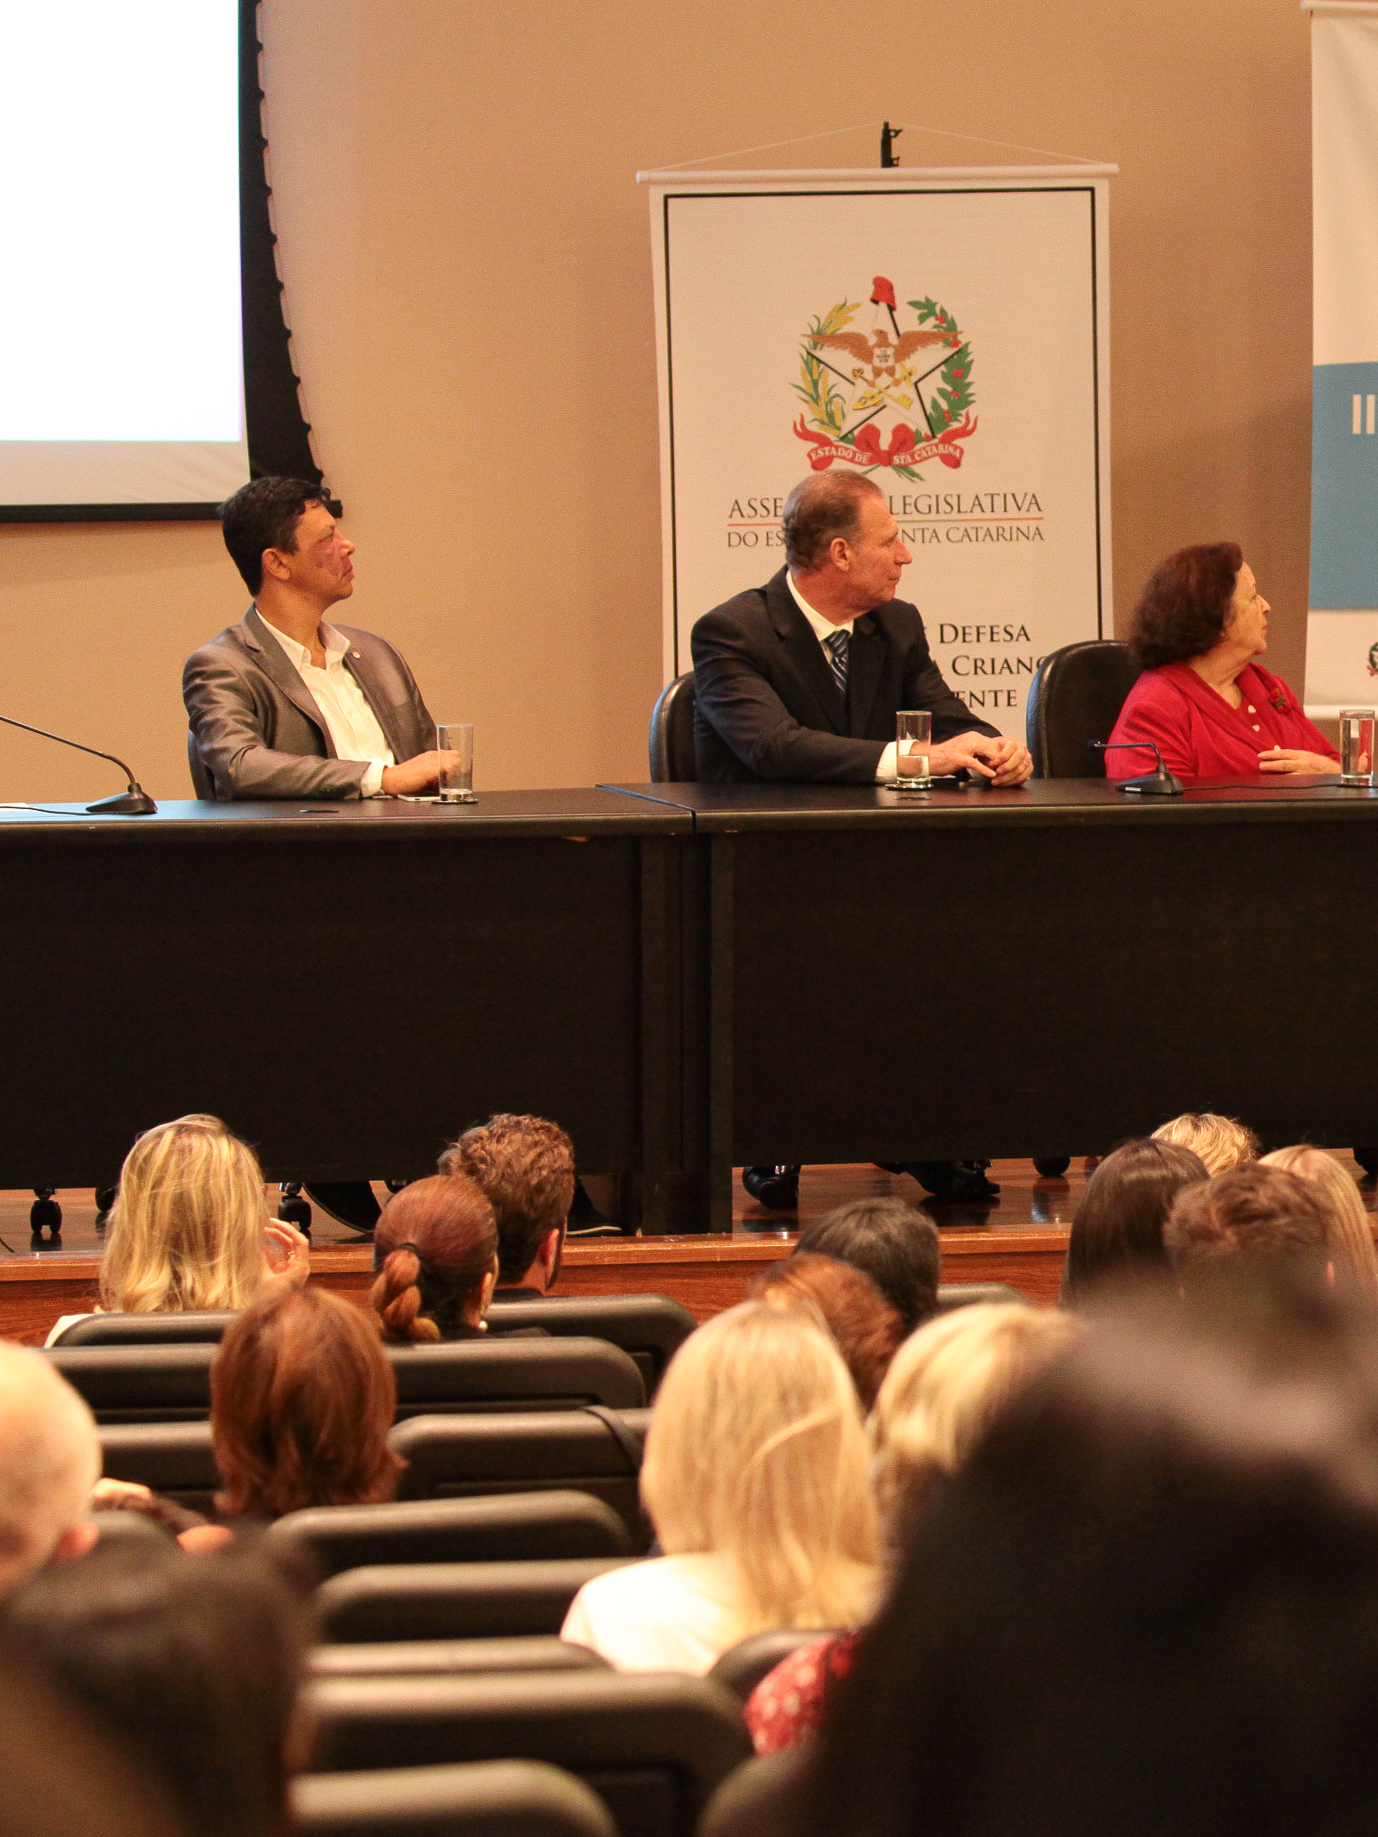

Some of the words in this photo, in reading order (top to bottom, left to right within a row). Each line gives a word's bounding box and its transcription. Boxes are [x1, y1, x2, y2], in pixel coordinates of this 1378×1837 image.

[1351, 394, 1376, 435] II
[810, 444, 853, 460] ESTADO
[854, 453, 871, 464] DE
[914, 444, 961, 460] CATARINA
[888, 492, 1044, 515] LEGISLATIVA
[727, 531, 759, 547] DO
[945, 524, 1044, 543] CATARINA
